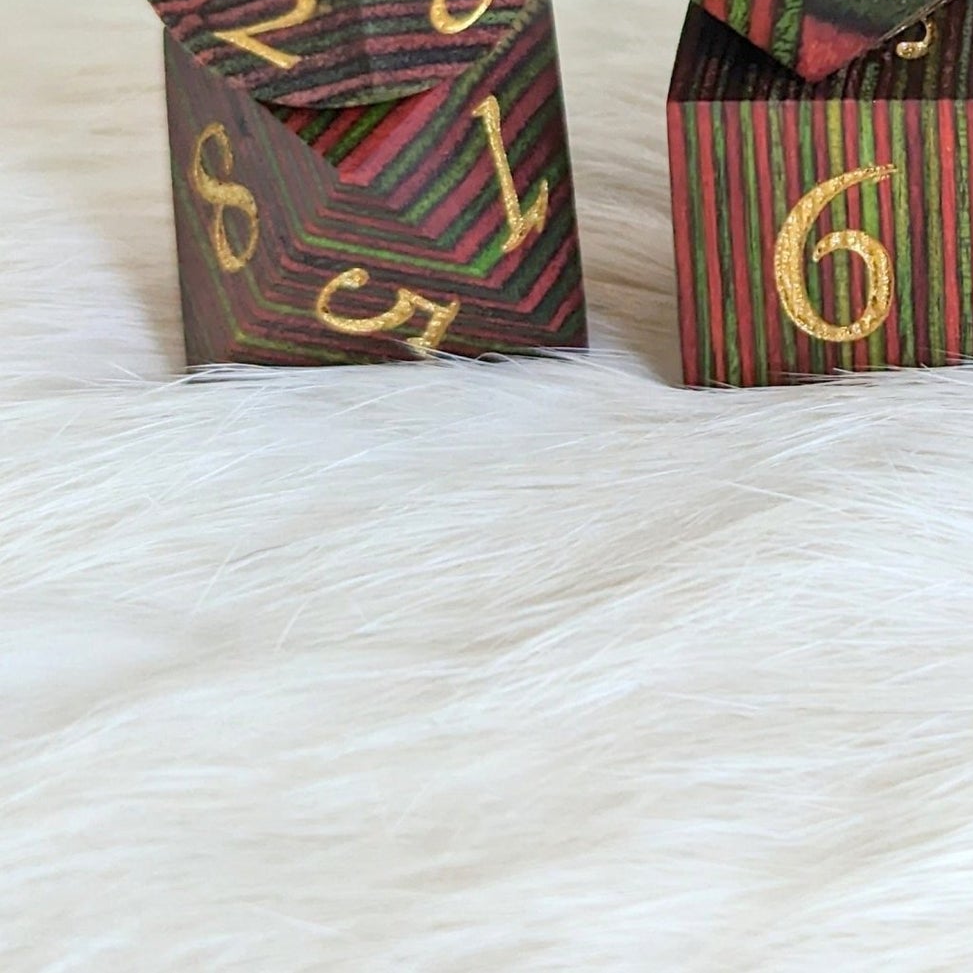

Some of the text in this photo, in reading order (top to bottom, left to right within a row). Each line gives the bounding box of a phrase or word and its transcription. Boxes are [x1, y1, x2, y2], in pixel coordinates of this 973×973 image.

[192, 122, 259, 273] 8
[774, 163, 899, 343] 6
[316, 267, 460, 357] 5
